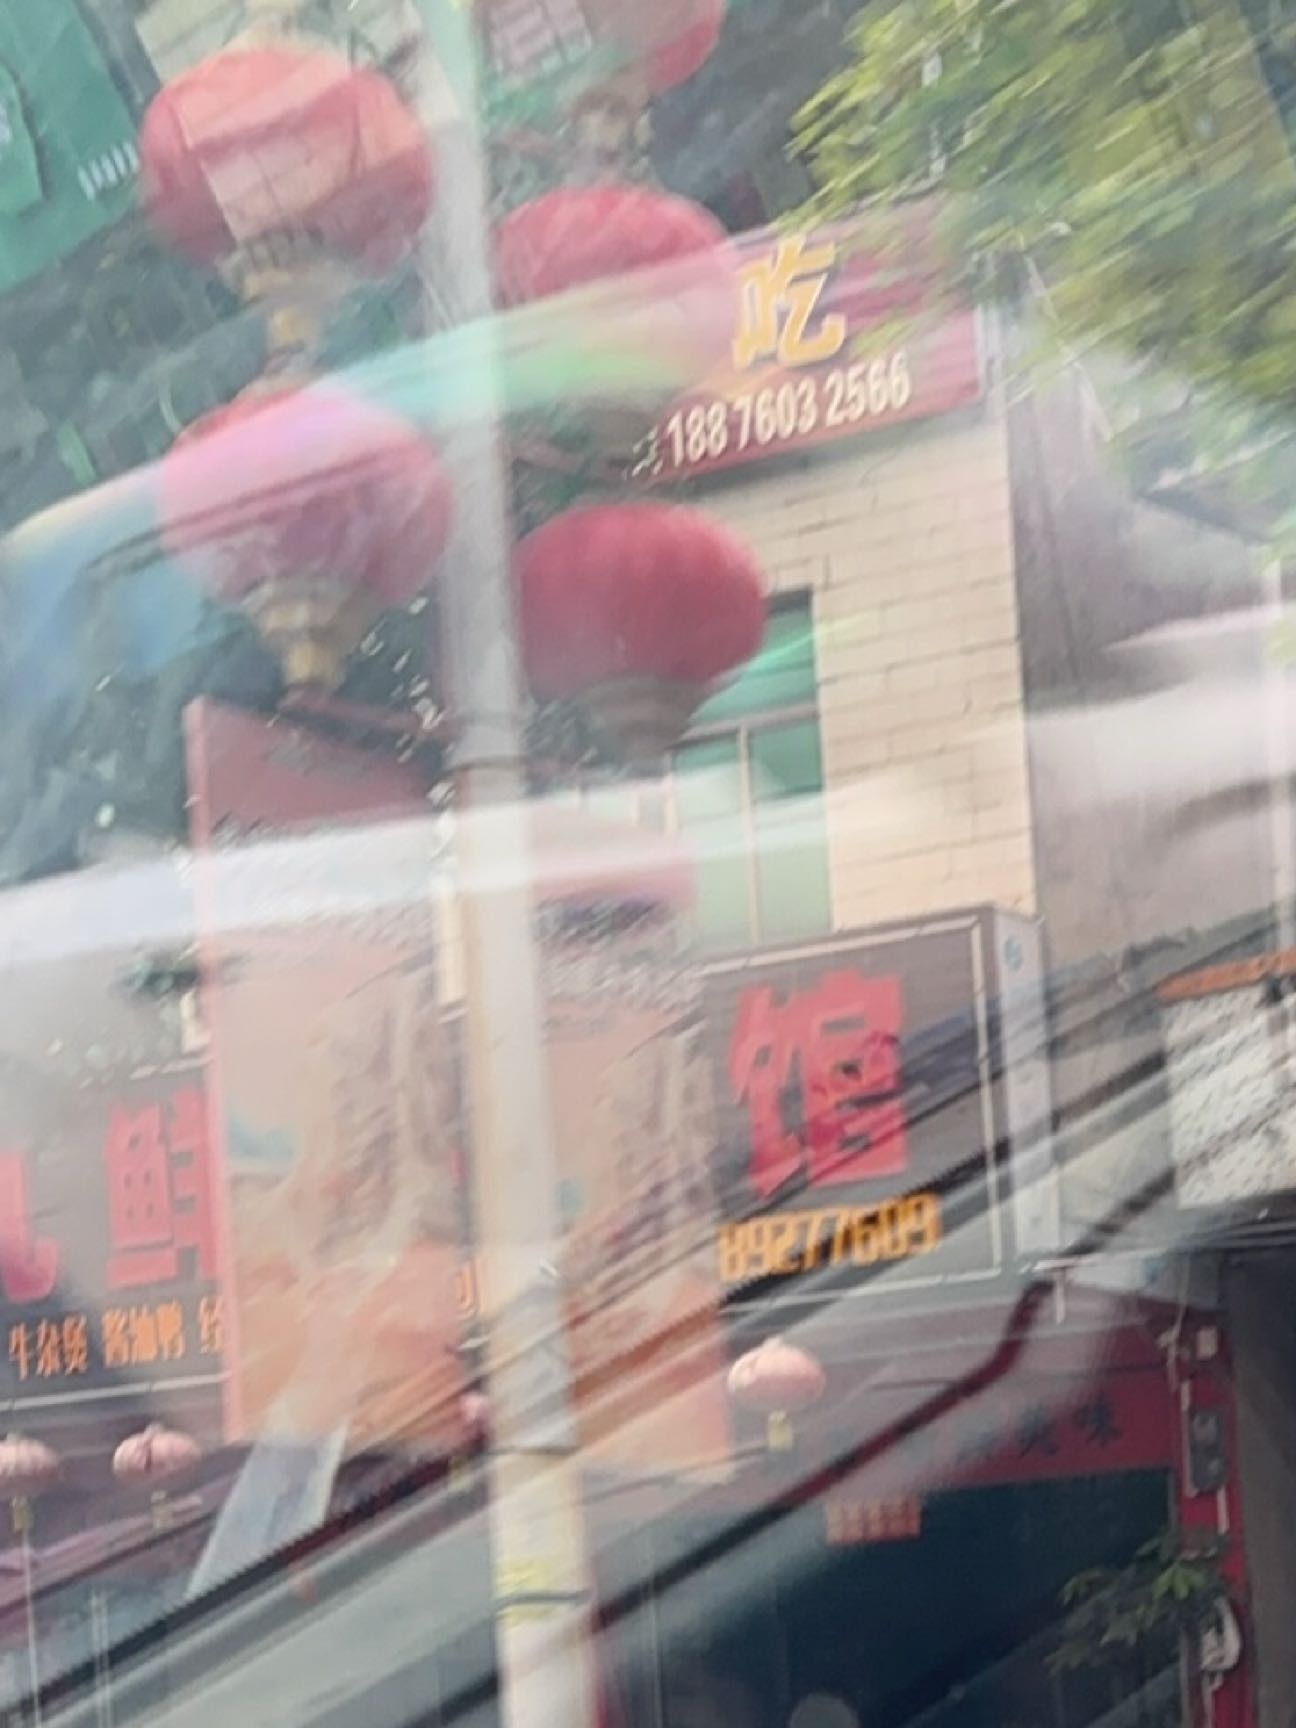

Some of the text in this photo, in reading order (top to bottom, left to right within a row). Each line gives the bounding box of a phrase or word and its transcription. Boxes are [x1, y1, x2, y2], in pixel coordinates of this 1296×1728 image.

[733, 233, 846, 371] 吃
[667, 400, 728, 468] 188
[735, 376, 818, 453] 7603
[823, 350, 913, 427] 2566
[729, 962, 909, 1200] 馆
